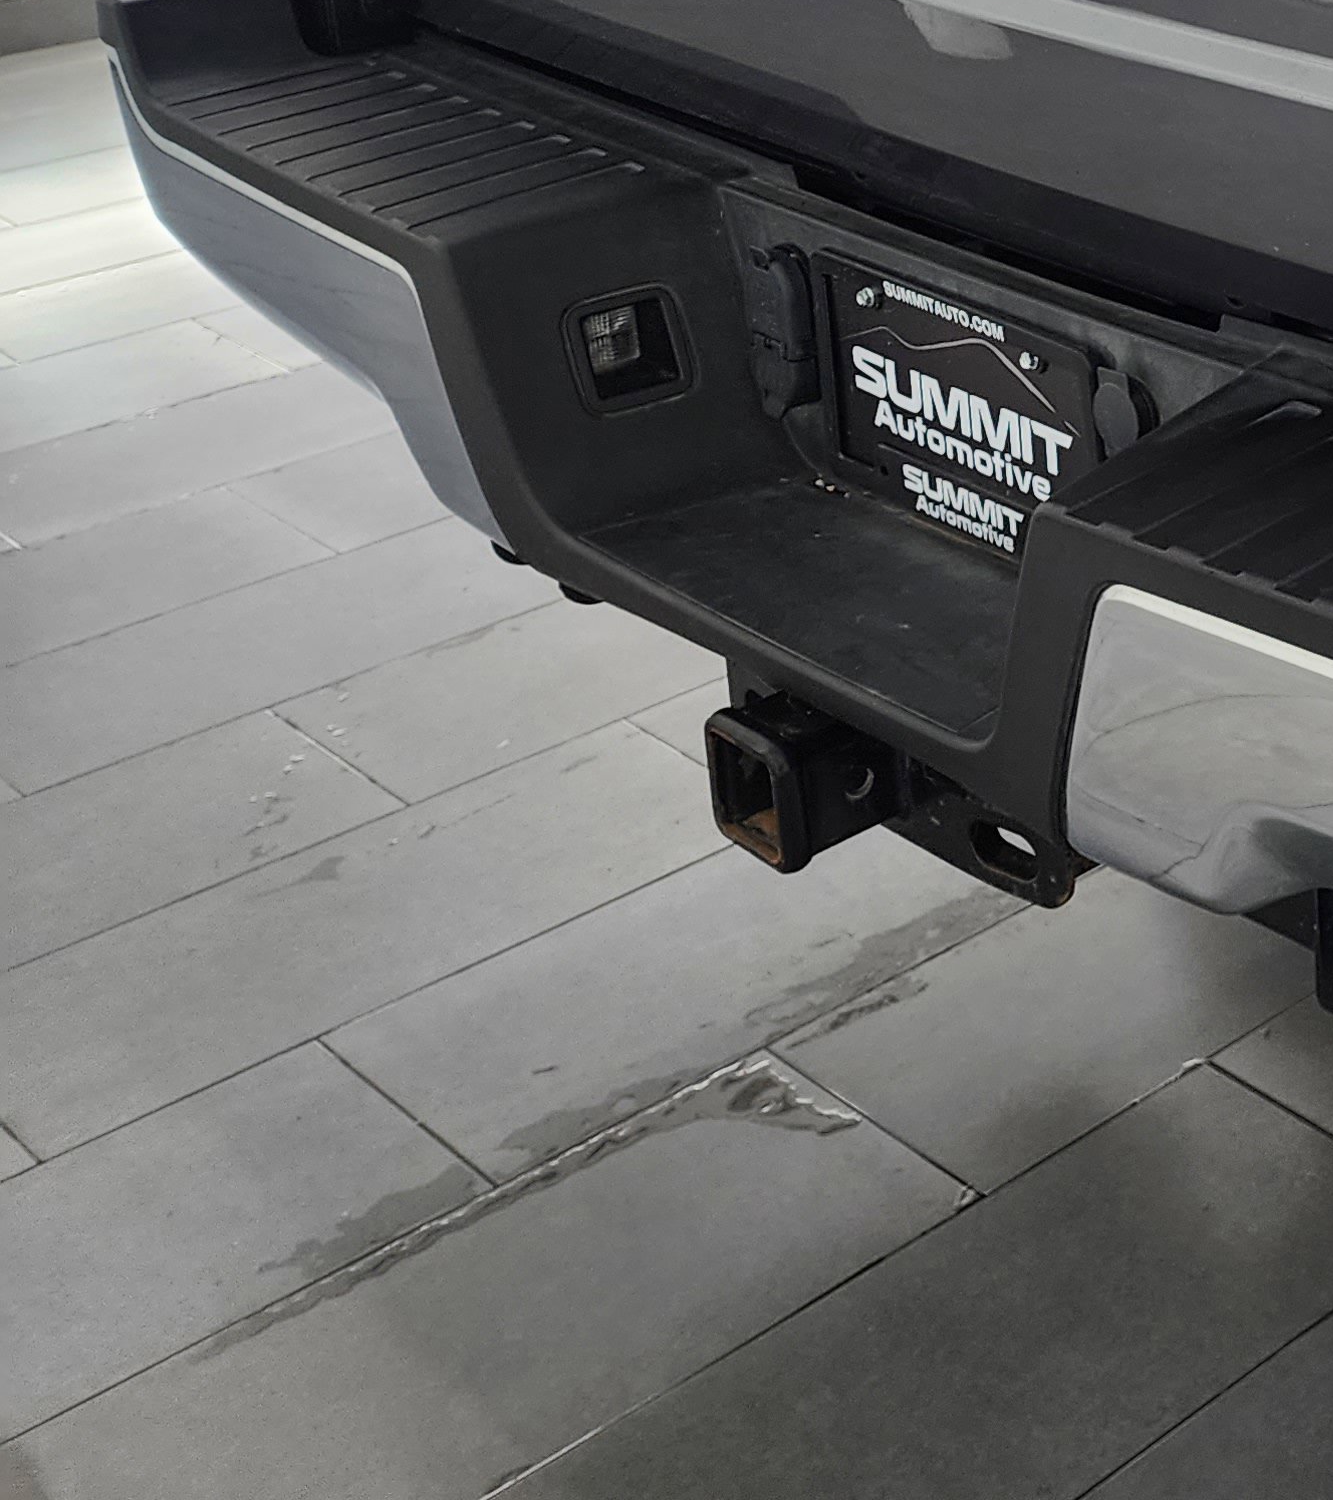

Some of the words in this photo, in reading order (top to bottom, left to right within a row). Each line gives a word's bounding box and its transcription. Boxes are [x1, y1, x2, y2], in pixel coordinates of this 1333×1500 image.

[882, 280, 1005, 342] SUMMITAUTO.COM
[852, 345, 1073, 476] SUMMIT
[874, 400, 1053, 502] Automotive
[902, 463, 1025, 537] SUMMIT
[915, 494, 1015, 553] Automotive
